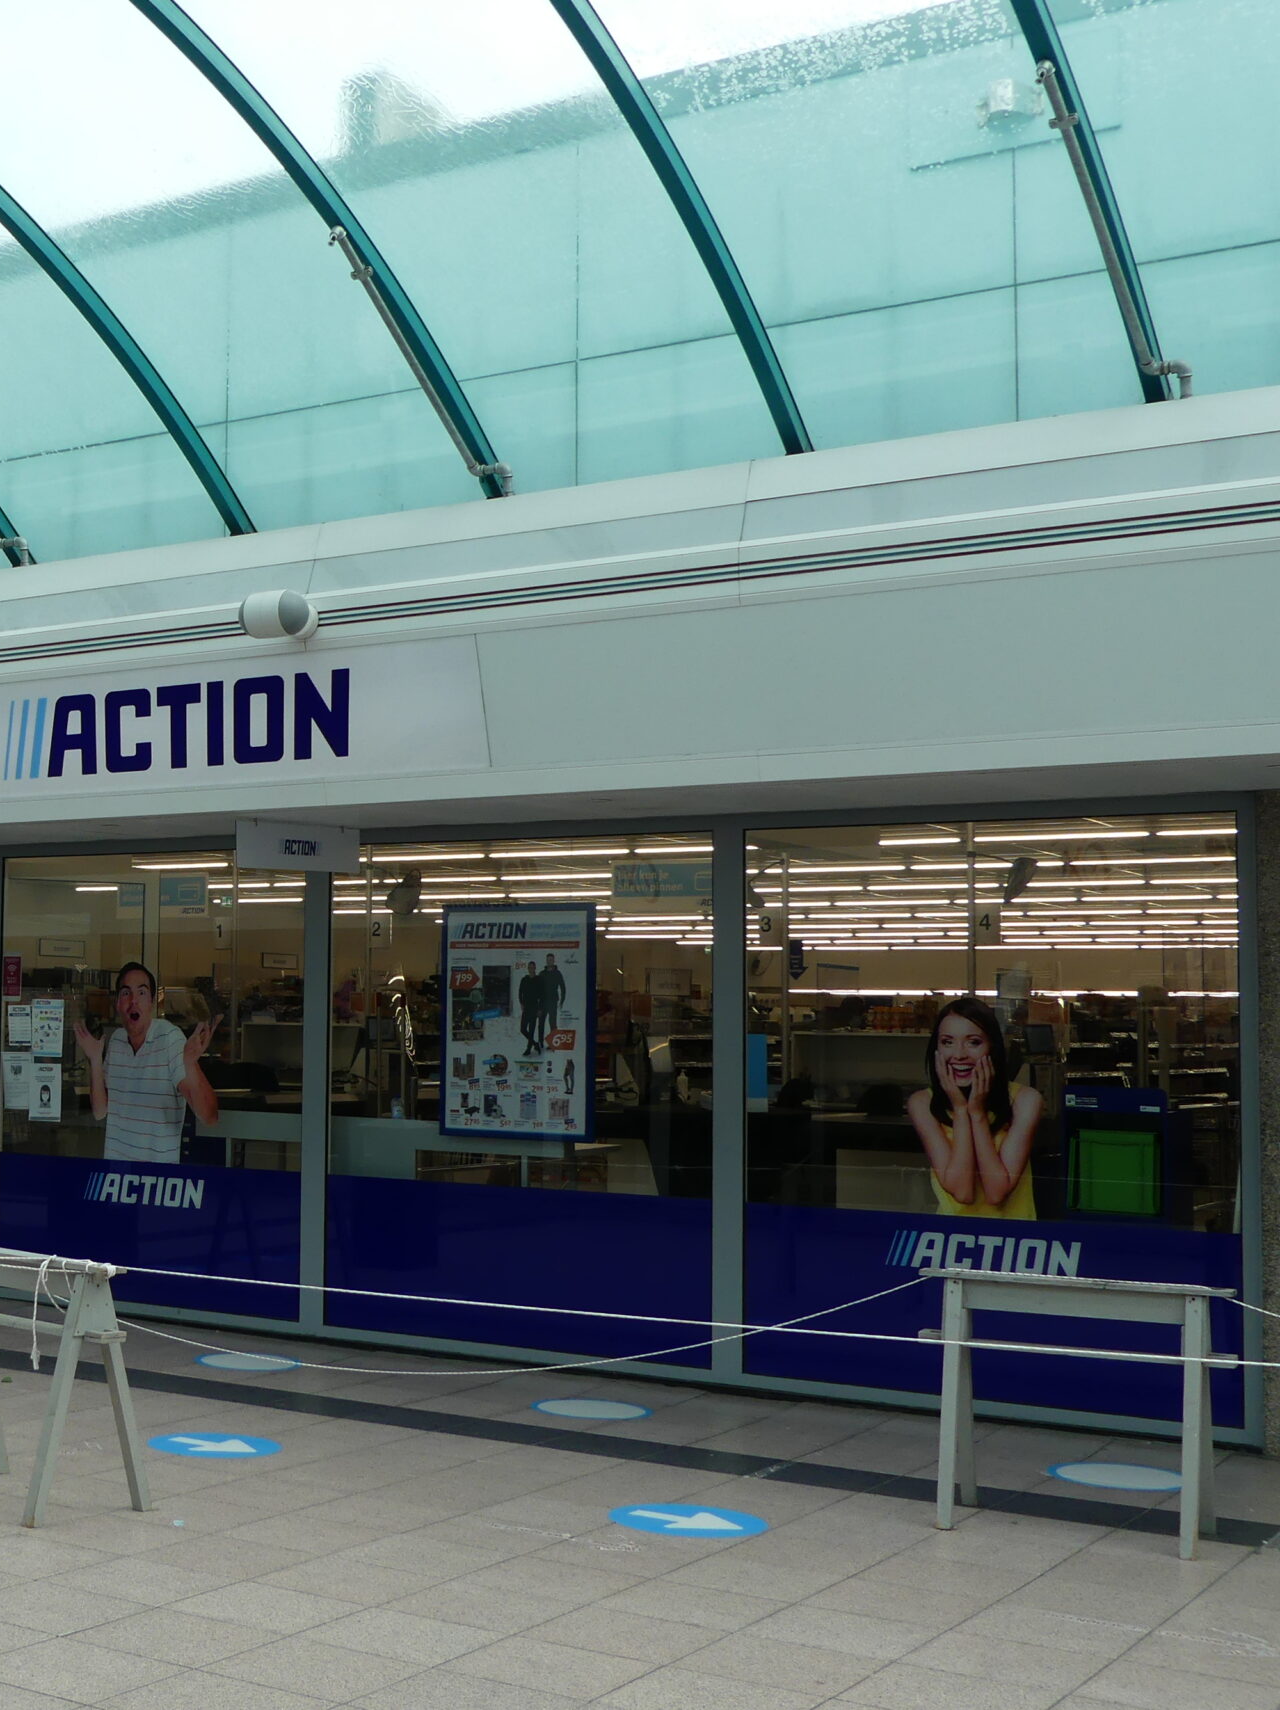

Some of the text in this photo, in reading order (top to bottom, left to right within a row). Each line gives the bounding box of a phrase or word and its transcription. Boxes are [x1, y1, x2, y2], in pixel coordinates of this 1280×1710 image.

[48, 668, 350, 778] ACTION
[284, 840, 317, 857] ACTION
[216, 924, 223, 938] 1
[372, 922, 381, 937] 2
[461, 922, 528, 939] ACTION
[760, 916, 772, 933] 3
[979, 914, 992, 931] 4
[99, 1173, 205, 1209] ACTION
[910, 1231, 1082, 1277] ACTION
